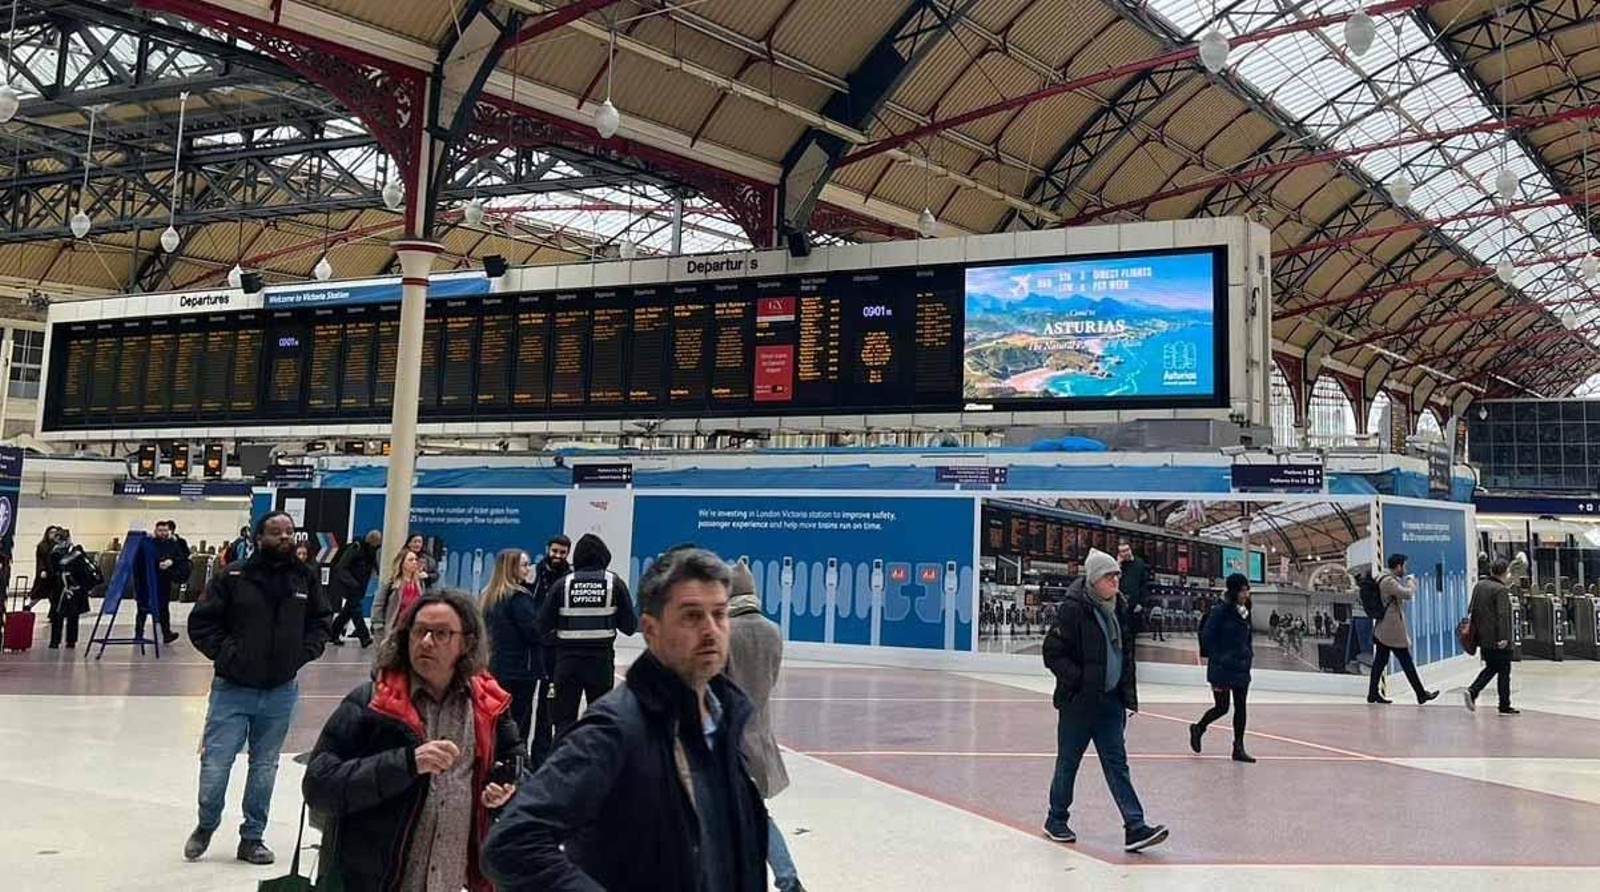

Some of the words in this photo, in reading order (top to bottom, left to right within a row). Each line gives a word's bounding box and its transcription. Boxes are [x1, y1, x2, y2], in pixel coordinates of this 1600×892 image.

[1093, 269, 1119, 280] DIRECT
[1121, 266, 1152, 278] FLIGHTS
[180, 294, 230, 307] Departures
[269, 295, 295, 303] Welcome
[296, 294, 302, 302] to
[303, 292, 326, 301] Victoria
[327, 291, 350, 300] Station
[1043, 318, 1126, 336] ASTURIAS
[699, 509, 717, 518] We're
[718, 510, 748, 520] investing
[749, 510, 755, 518] in
[756, 510, 781, 518] London
[782, 510, 808, 519] Victoria
[809, 511, 832, 519] station
[832, 511, 841, 519] to
[842, 511, 871, 521] improve
[872, 510, 897, 521] safety,
[698, 521, 731, 530] passenger
[732, 521, 768, 530] experience
[769, 521, 782, 529] and
[784, 520, 799, 531] help
[799, 522, 817, 530] more
[818, 521, 838, 530] trains
[839, 522, 851, 530] run
[852, 522, 863, 530] on
